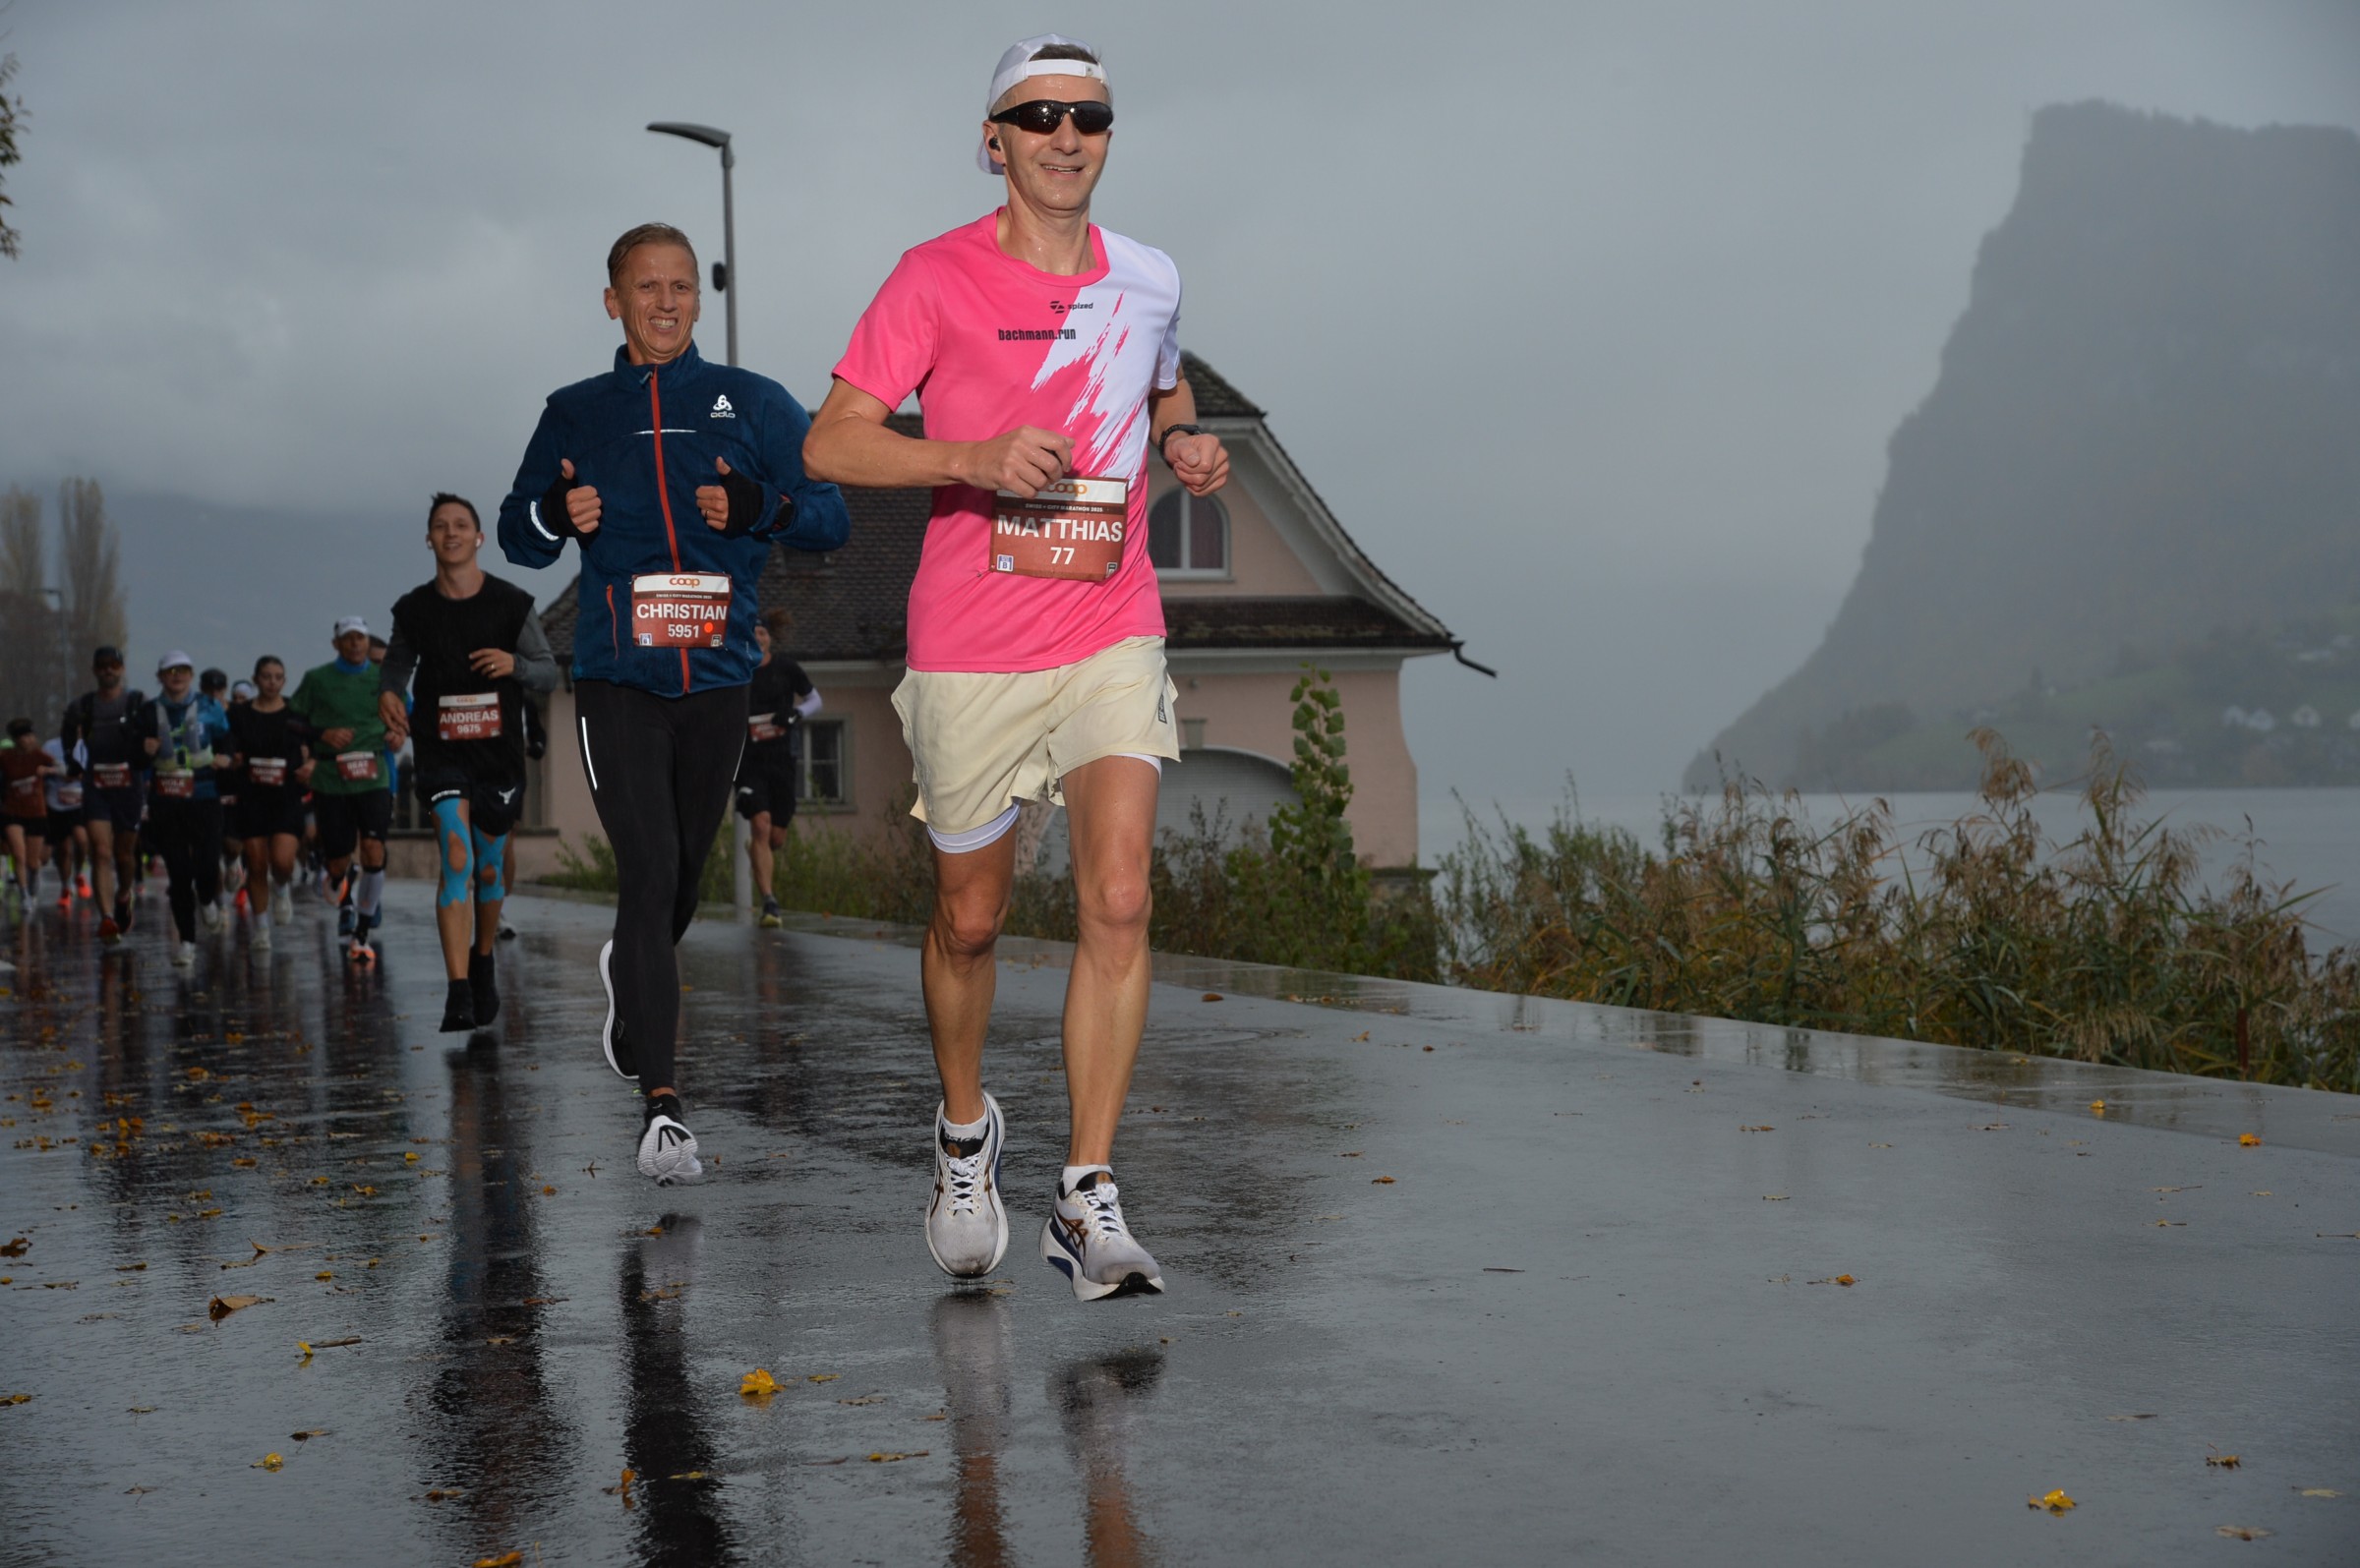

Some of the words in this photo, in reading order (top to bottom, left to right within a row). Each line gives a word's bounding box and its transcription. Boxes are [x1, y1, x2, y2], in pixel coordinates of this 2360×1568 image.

[1067, 302, 1093, 311] spized
[998, 328, 1076, 341] bachmann.run
[997, 514, 1123, 542] MATTHIAS
[1050, 547, 1075, 565] 77
[670, 578, 700, 588] coop
[636, 604, 728, 620] CHRISTIAN
[668, 623, 699, 638] 5951
[440, 710, 499, 725] ANDREAS
